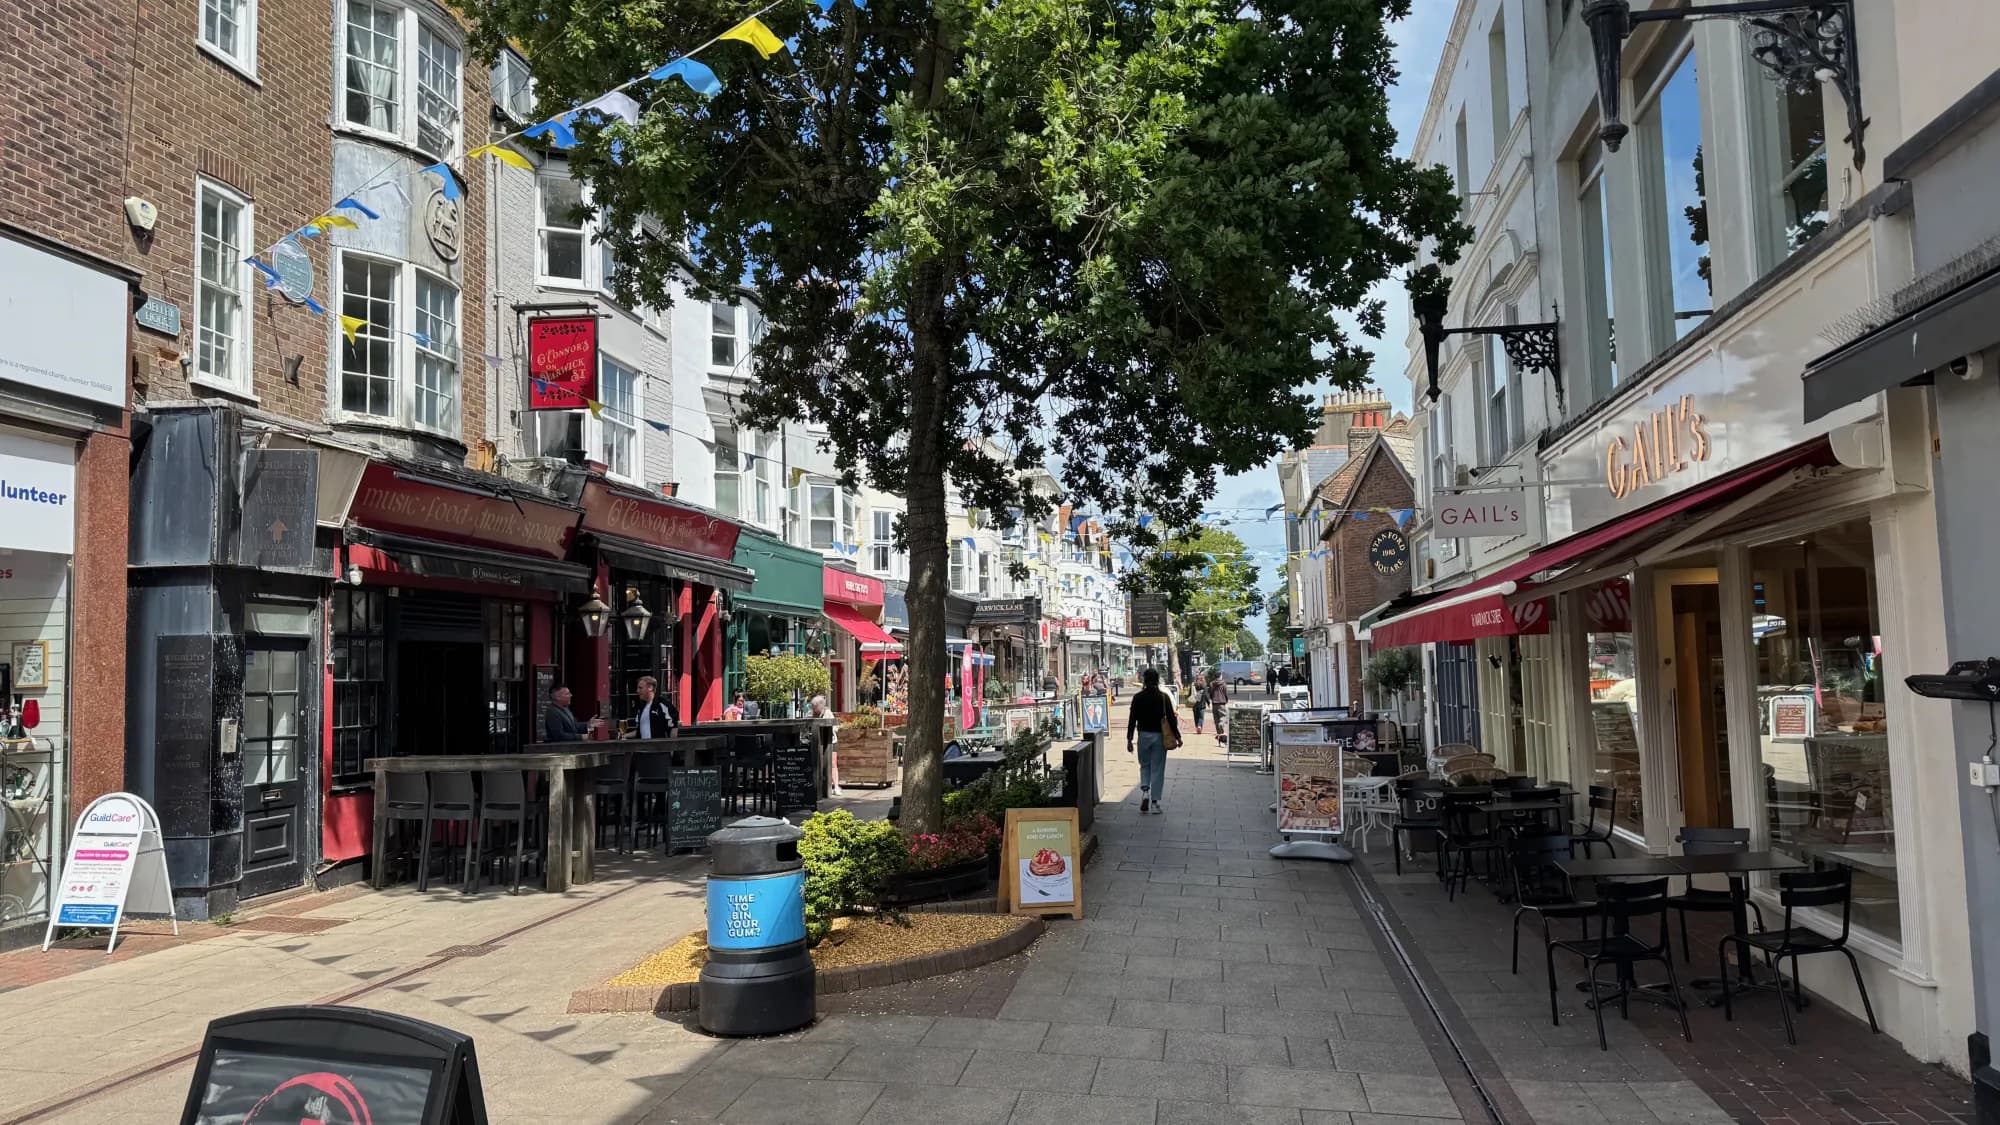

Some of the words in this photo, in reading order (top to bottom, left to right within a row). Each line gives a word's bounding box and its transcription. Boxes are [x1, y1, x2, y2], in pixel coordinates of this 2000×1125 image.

[145, 302, 176, 318] HELLEY
[145, 311, 172, 329] HOUSE
[19, 363, 48, 376] registered
[69, 376, 89, 386] number
[540, 358, 585, 382] WARWICK
[571, 369, 587, 382] ST
[363, 488, 419, 515] music
[425, 496, 470, 526] food
[474, 508, 517, 535] drink
[1441, 504, 1519, 525] GAIL's
[1372, 531, 1407, 552] STANFORD
[1374, 558, 1404, 574] SQUARE
[976, 604, 1005, 612] WARWICK
[728, 894, 756, 903] TIME
[734, 903, 749, 911] TO
[732, 911, 751, 920] BIN
[727, 920, 759, 929] YOUR
[728, 928, 761, 937] GUM?
